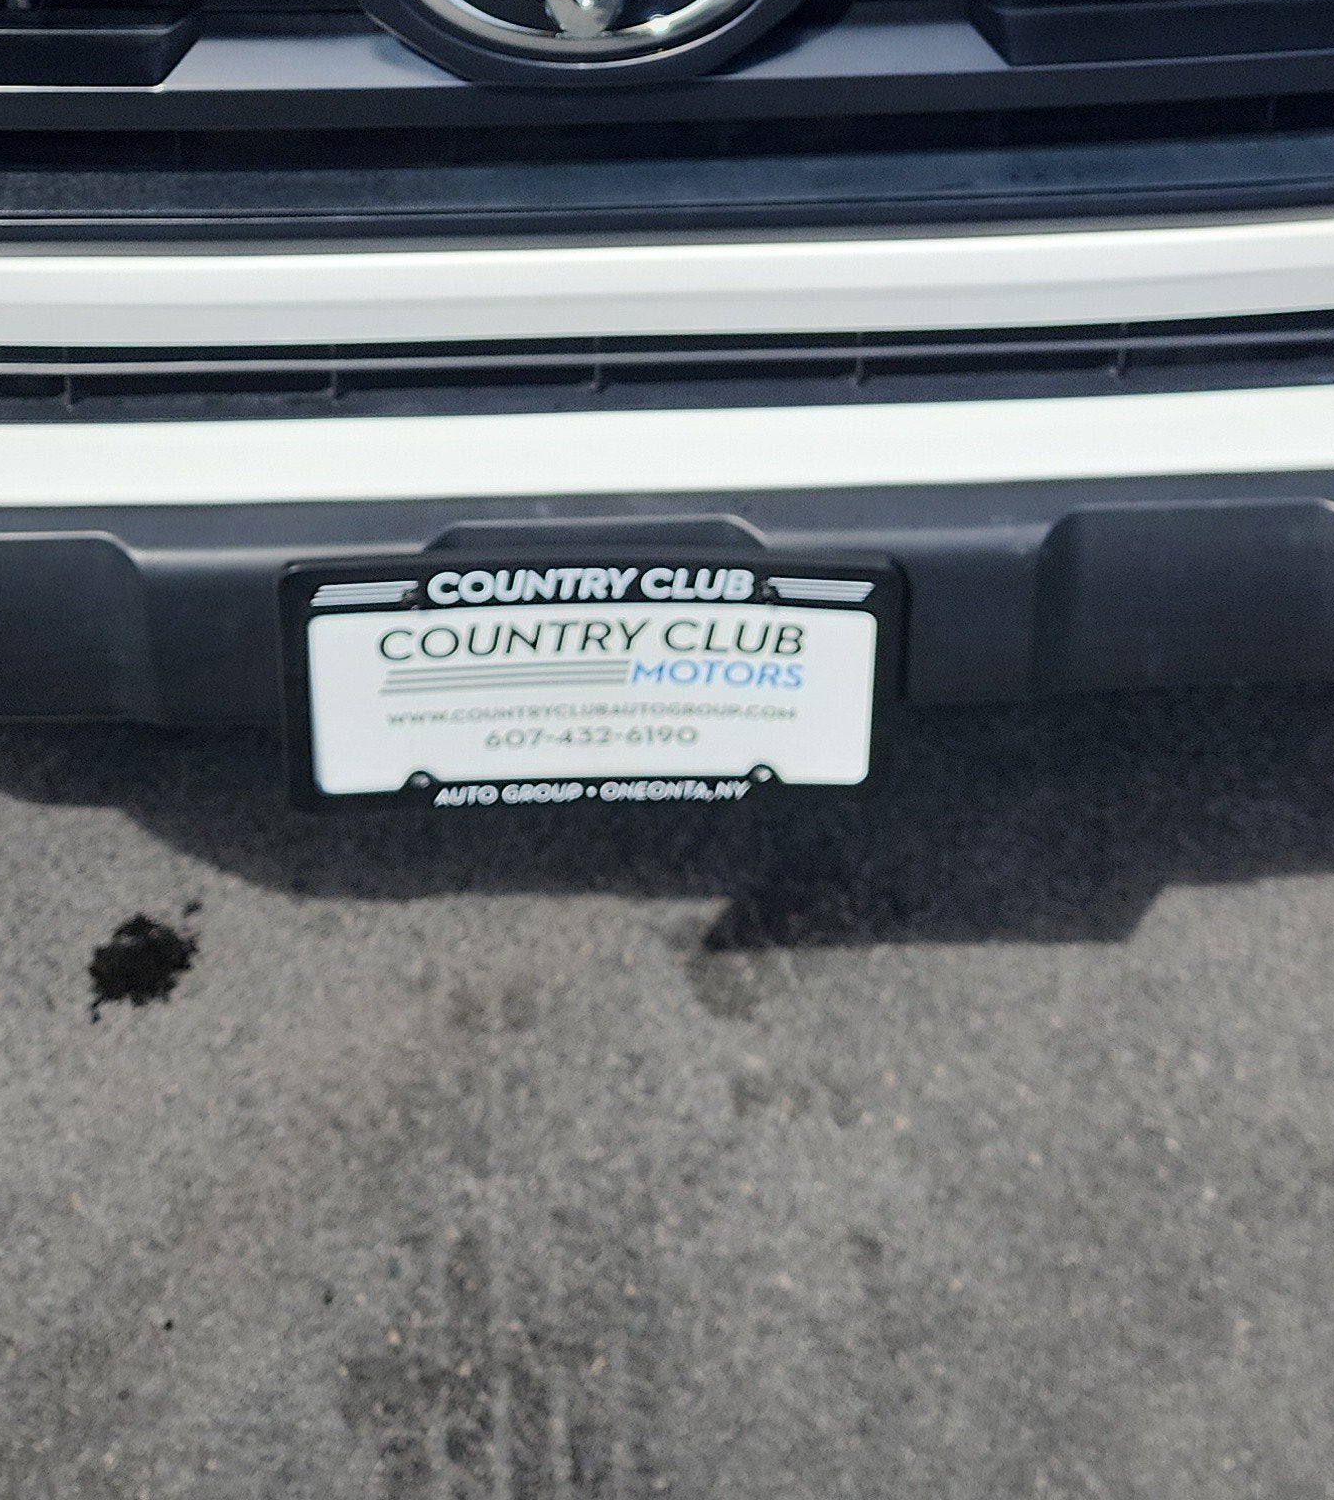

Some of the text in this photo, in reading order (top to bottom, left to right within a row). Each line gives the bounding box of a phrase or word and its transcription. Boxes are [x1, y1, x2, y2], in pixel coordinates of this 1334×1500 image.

[427, 568, 754, 605] COUNTRY CLUB
[380, 620, 805, 660] COUNTRY CLUB
[631, 661, 805, 688] MOTORS
[485, 726, 698, 749] 607-432-6190
[434, 785, 499, 807] AUTO
[502, 782, 584, 804] GROUP
